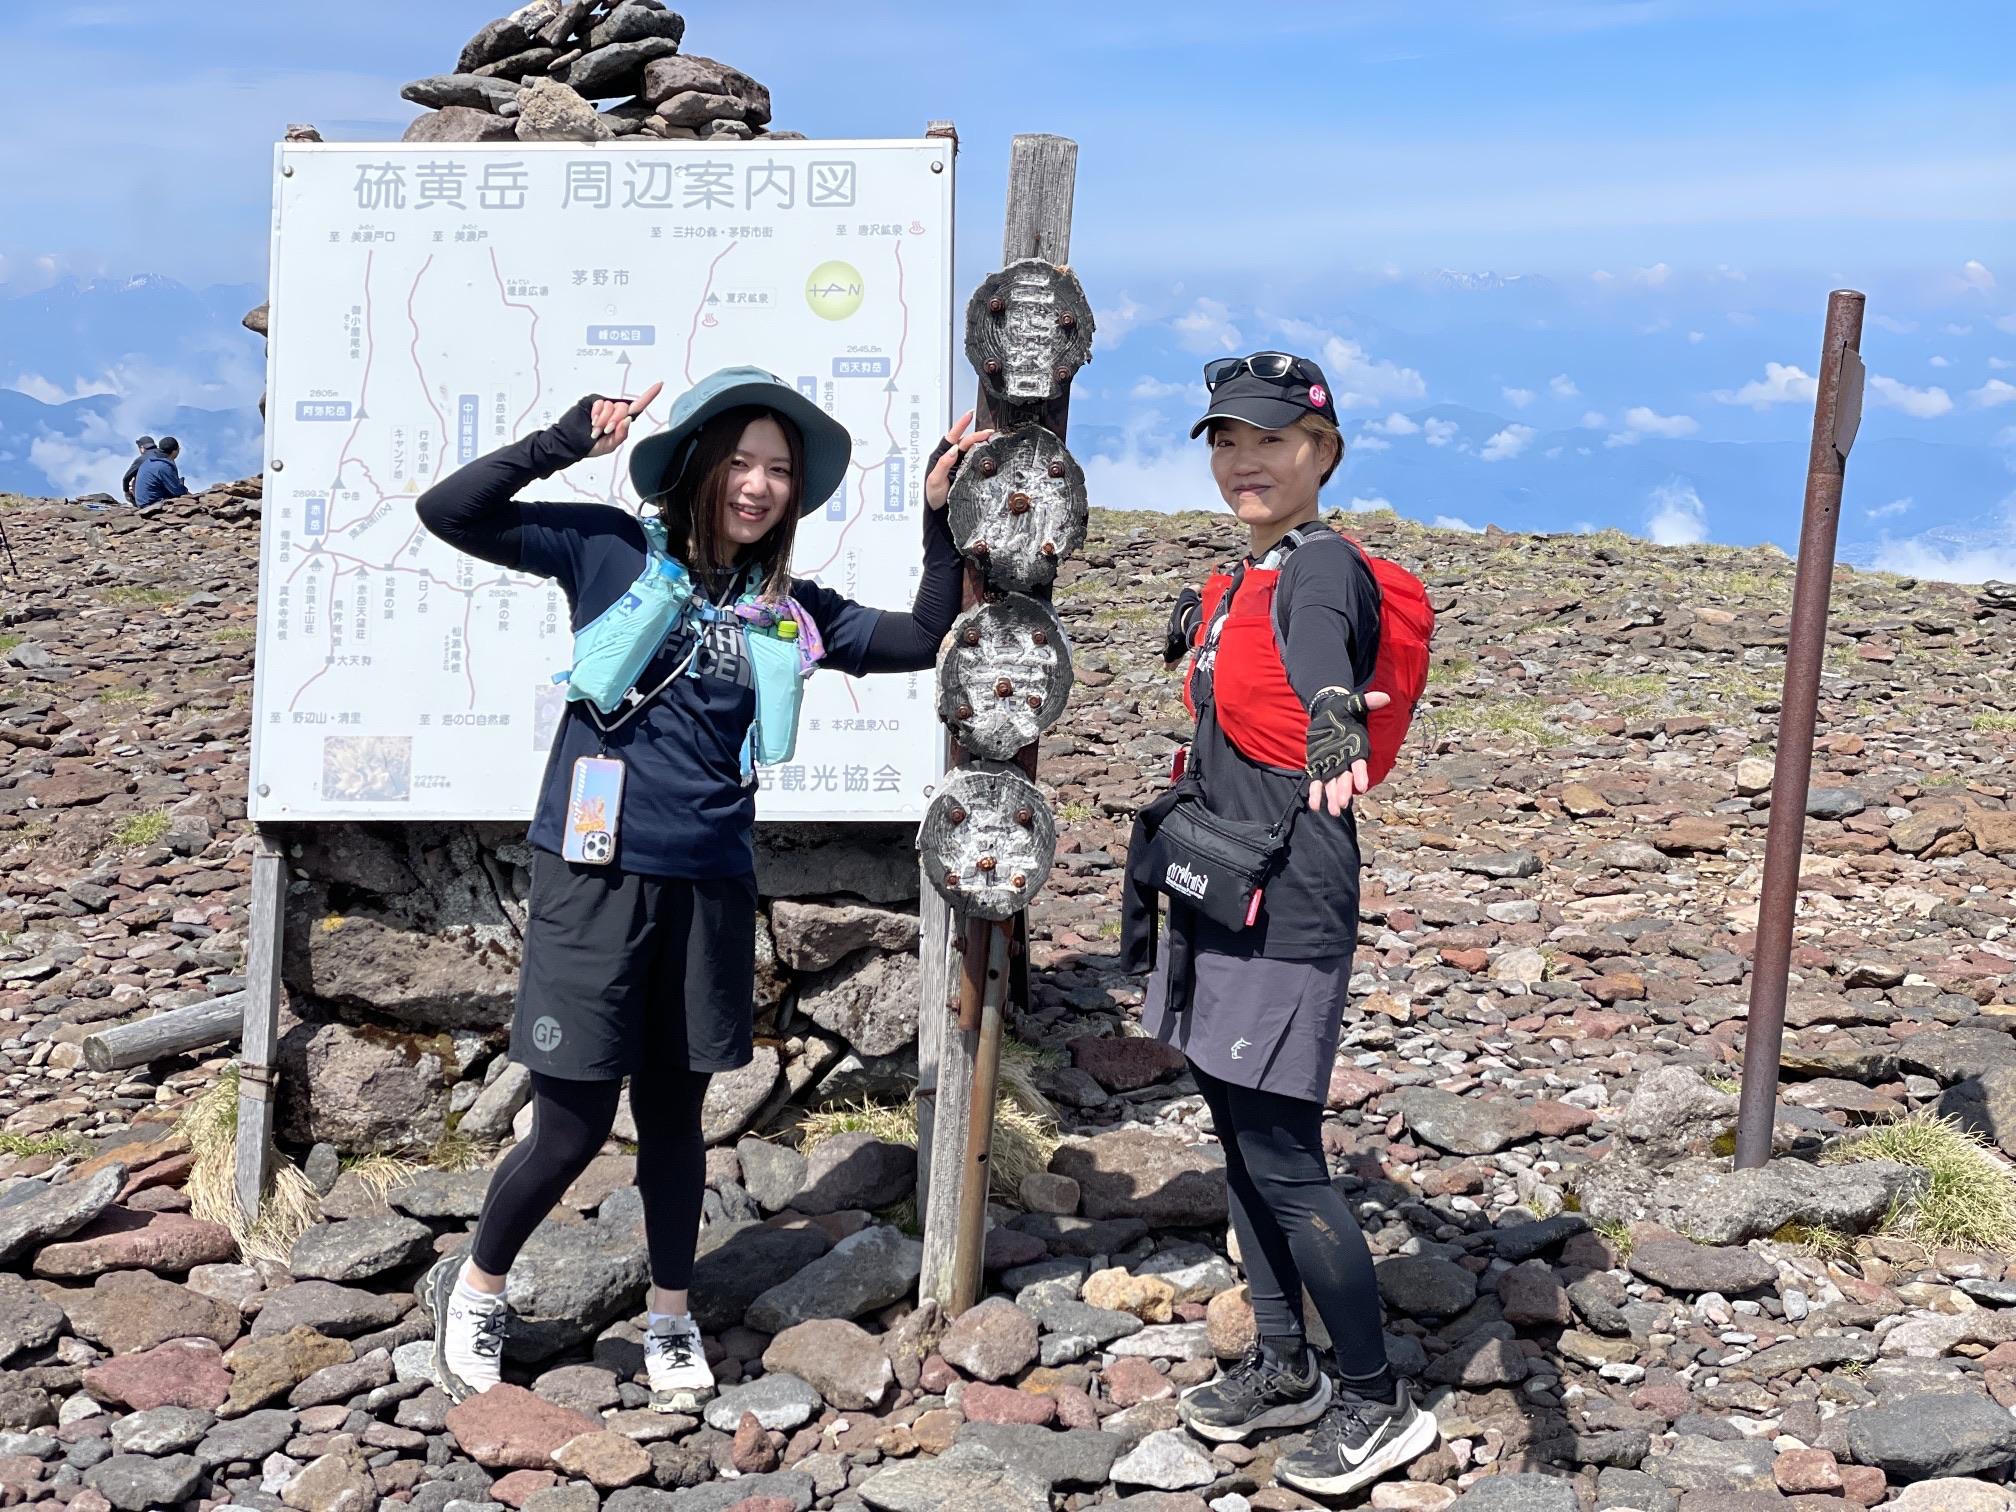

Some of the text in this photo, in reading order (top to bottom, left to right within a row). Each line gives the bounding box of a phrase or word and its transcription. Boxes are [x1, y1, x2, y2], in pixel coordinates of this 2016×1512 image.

[353, 158, 856, 211] 硫黄岳 周辺案内図
[650, 226, 773, 239] 至 三井の森・茅野市街
[836, 224, 902, 236] 至 唐沢鉱泉
[329, 232, 340, 242] 至
[432, 231, 443, 242] 至
[572, 269, 629, 286] 茅野市
[848, 284, 862, 296] N
[1309, 385, 1326, 403] GF
[270, 711, 361, 724] 至 野辺山・清里
[419, 714, 431, 725] 至
[809, 719, 899, 731] 至 本沢温泉入口
[535, 1023, 562, 1044] GF
